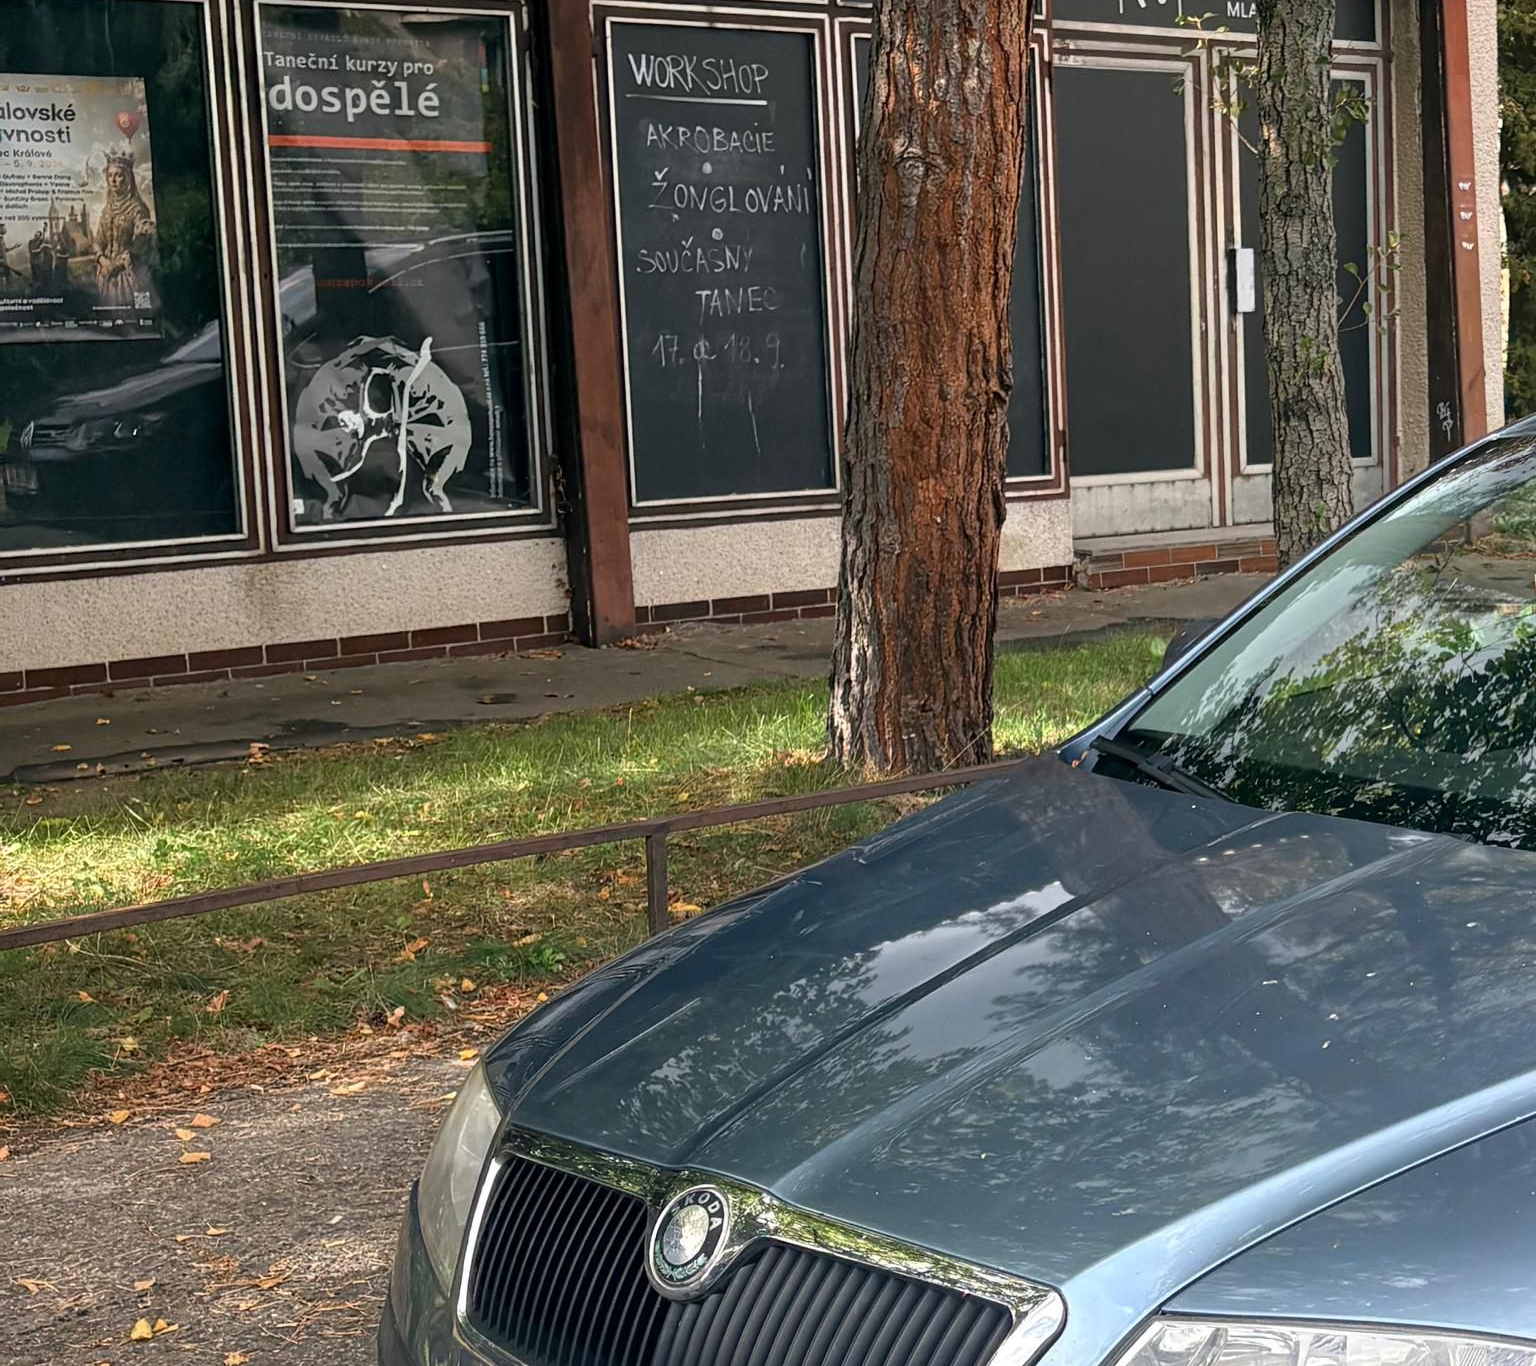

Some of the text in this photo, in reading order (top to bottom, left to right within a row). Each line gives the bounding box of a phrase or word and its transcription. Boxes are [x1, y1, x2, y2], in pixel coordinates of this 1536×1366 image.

[264, 51, 434, 77] Taneční kurzy pro
[628, 53, 769, 95] WORKSHOP
[268, 75, 440, 122] dospělé
[647, 123, 776, 154] AKROBACIE
[696, 286, 780, 323] TANEC
[651, 333, 684, 366] 17.
